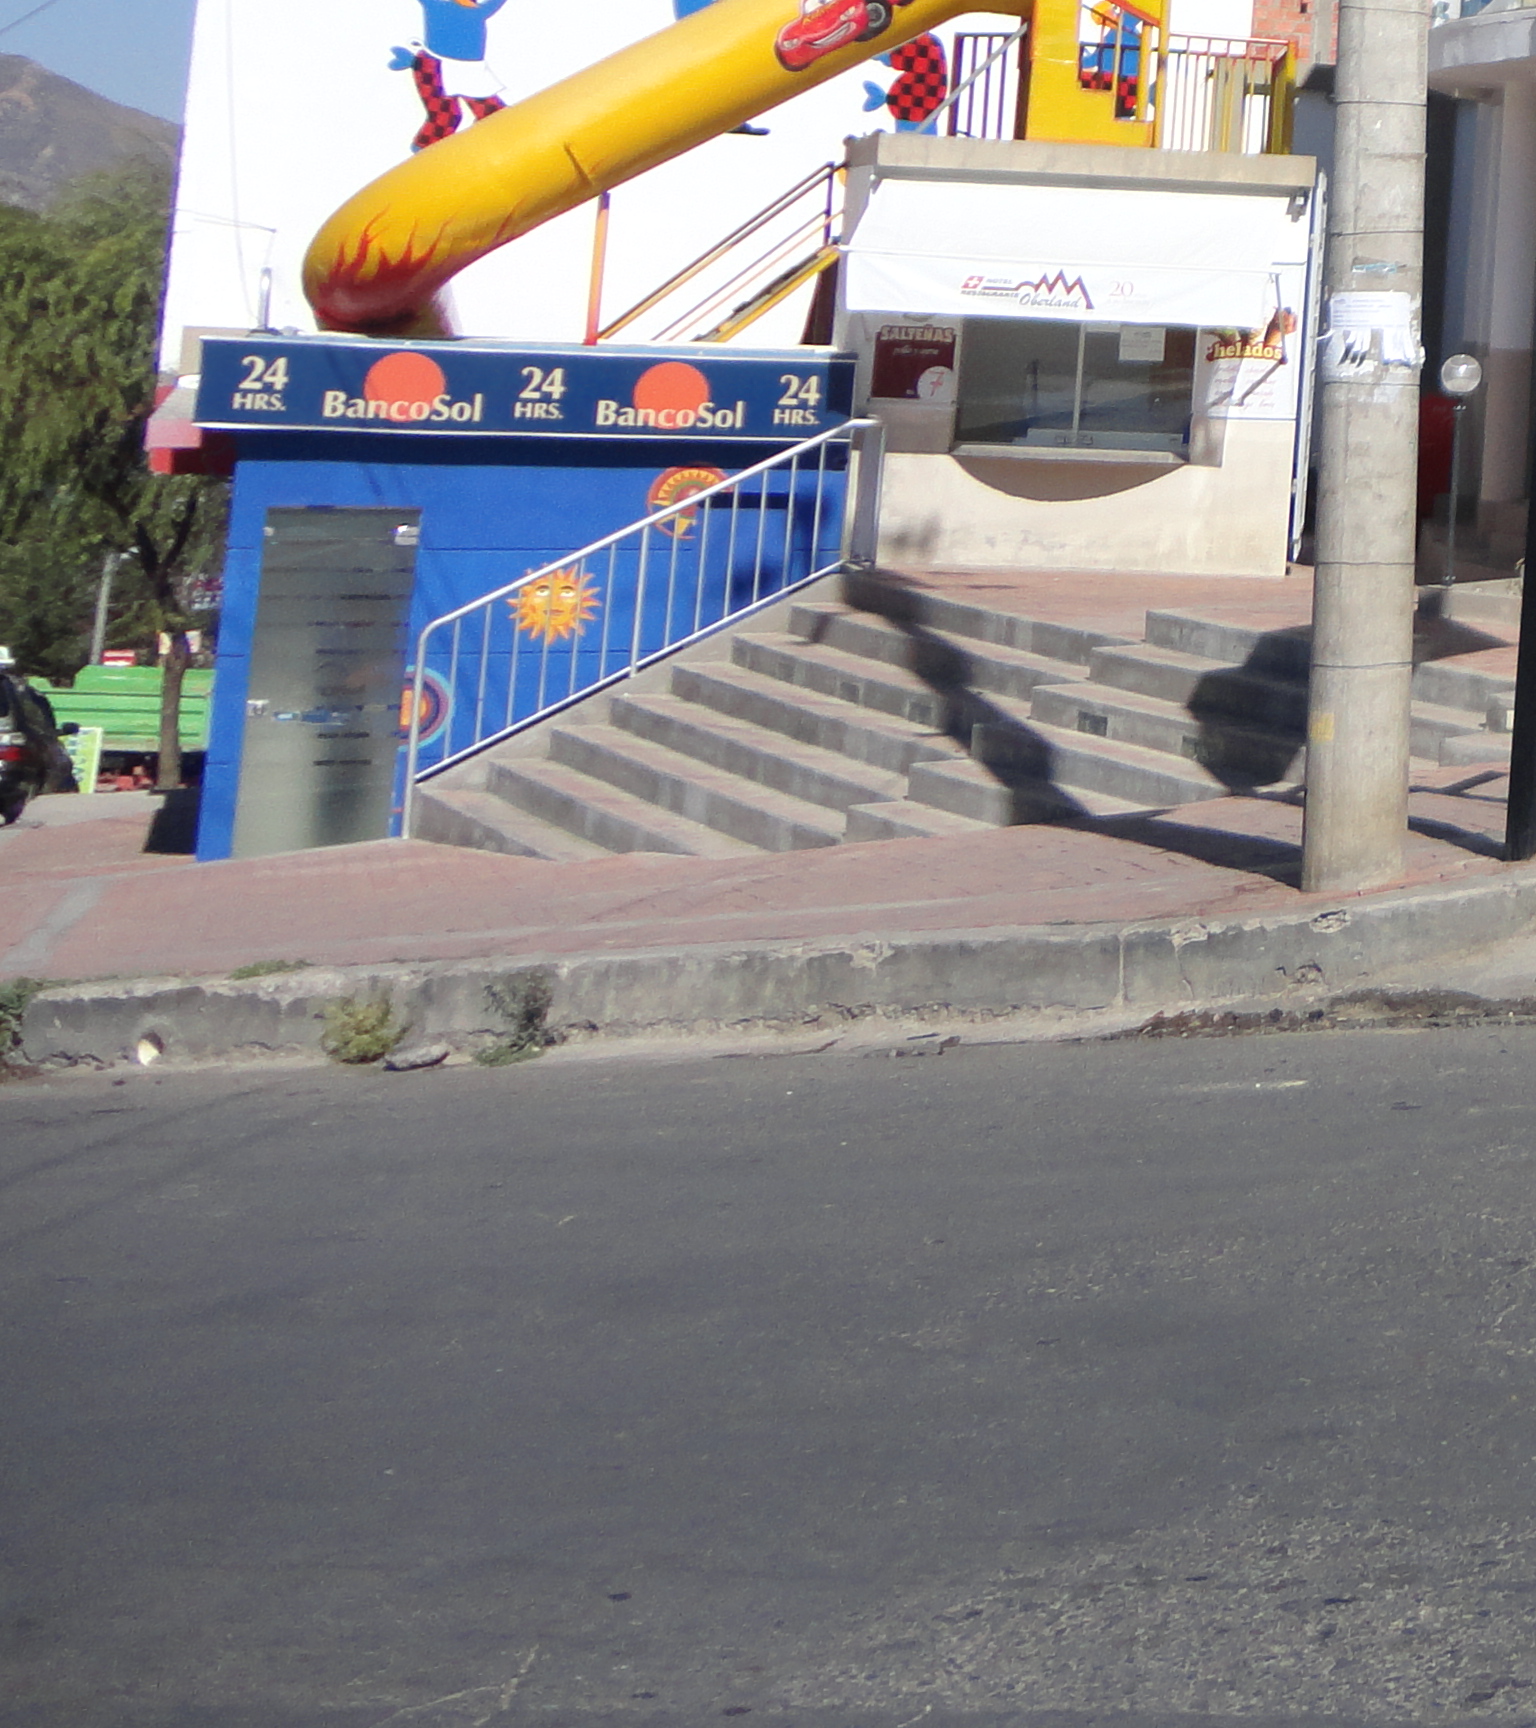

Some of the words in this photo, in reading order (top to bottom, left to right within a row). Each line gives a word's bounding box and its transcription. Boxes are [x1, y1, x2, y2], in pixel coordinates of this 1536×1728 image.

[1213, 341, 1283, 359] helados
[238, 355, 290, 391] 24
[518, 365, 566, 400] 24
[231, 392, 287, 412] HRS.
[777, 374, 821, 406] 24
[322, 389, 484, 423] BancoSol
[513, 401, 563, 419] HRS.
[595, 399, 745, 428] BancoSol
[772, 408, 820, 425] HRS.
